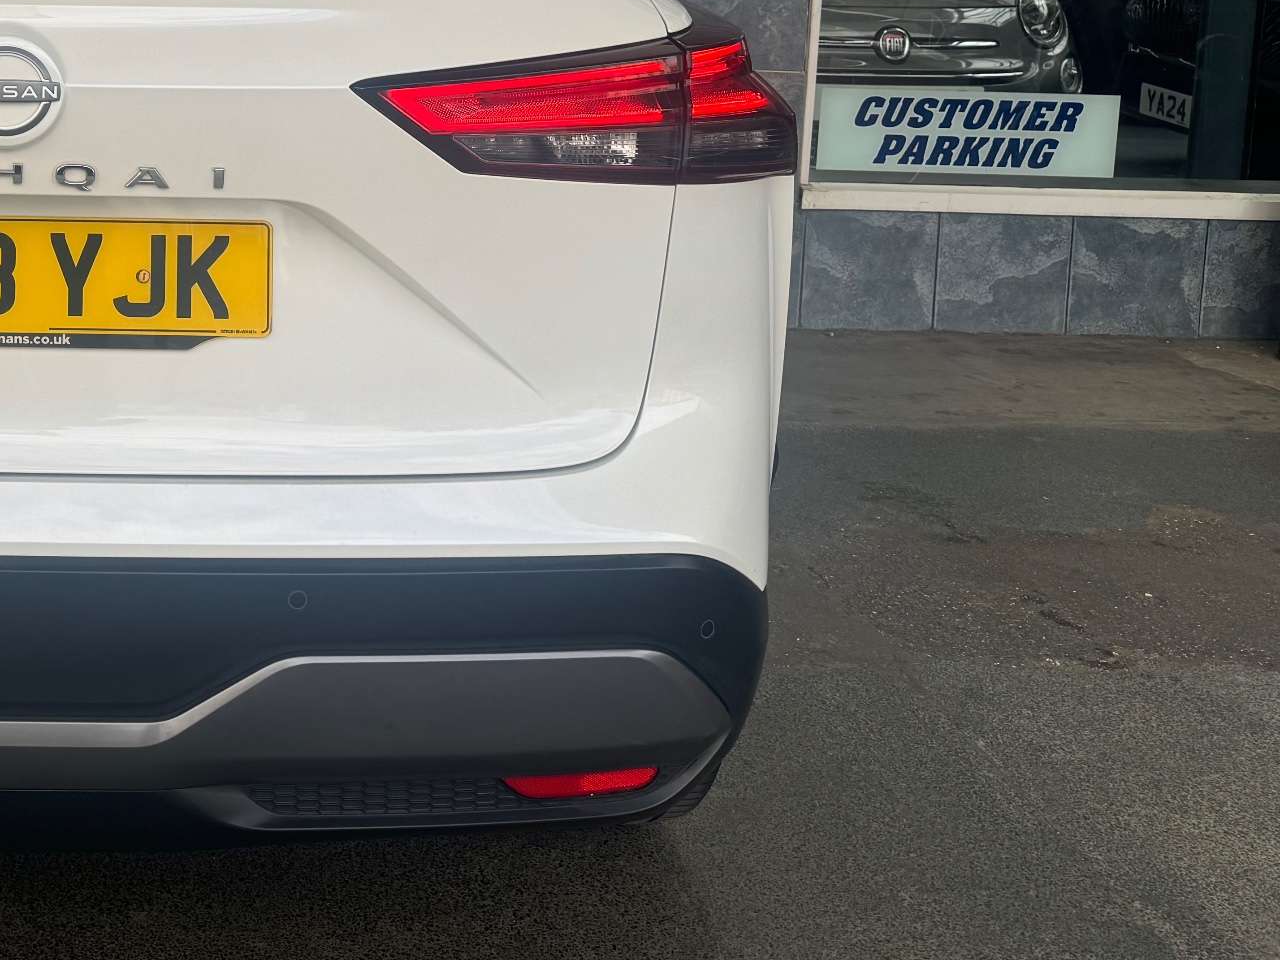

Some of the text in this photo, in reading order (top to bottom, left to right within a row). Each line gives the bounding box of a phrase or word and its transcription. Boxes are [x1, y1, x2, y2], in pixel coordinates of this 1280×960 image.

[885, 36, 904, 52] FIAT
[854, 95, 1084, 133] CUSTOMER
[1147, 87, 1186, 122] YA24
[872, 134, 1059, 169] PARKING
[50, 232, 230, 320] YJK
